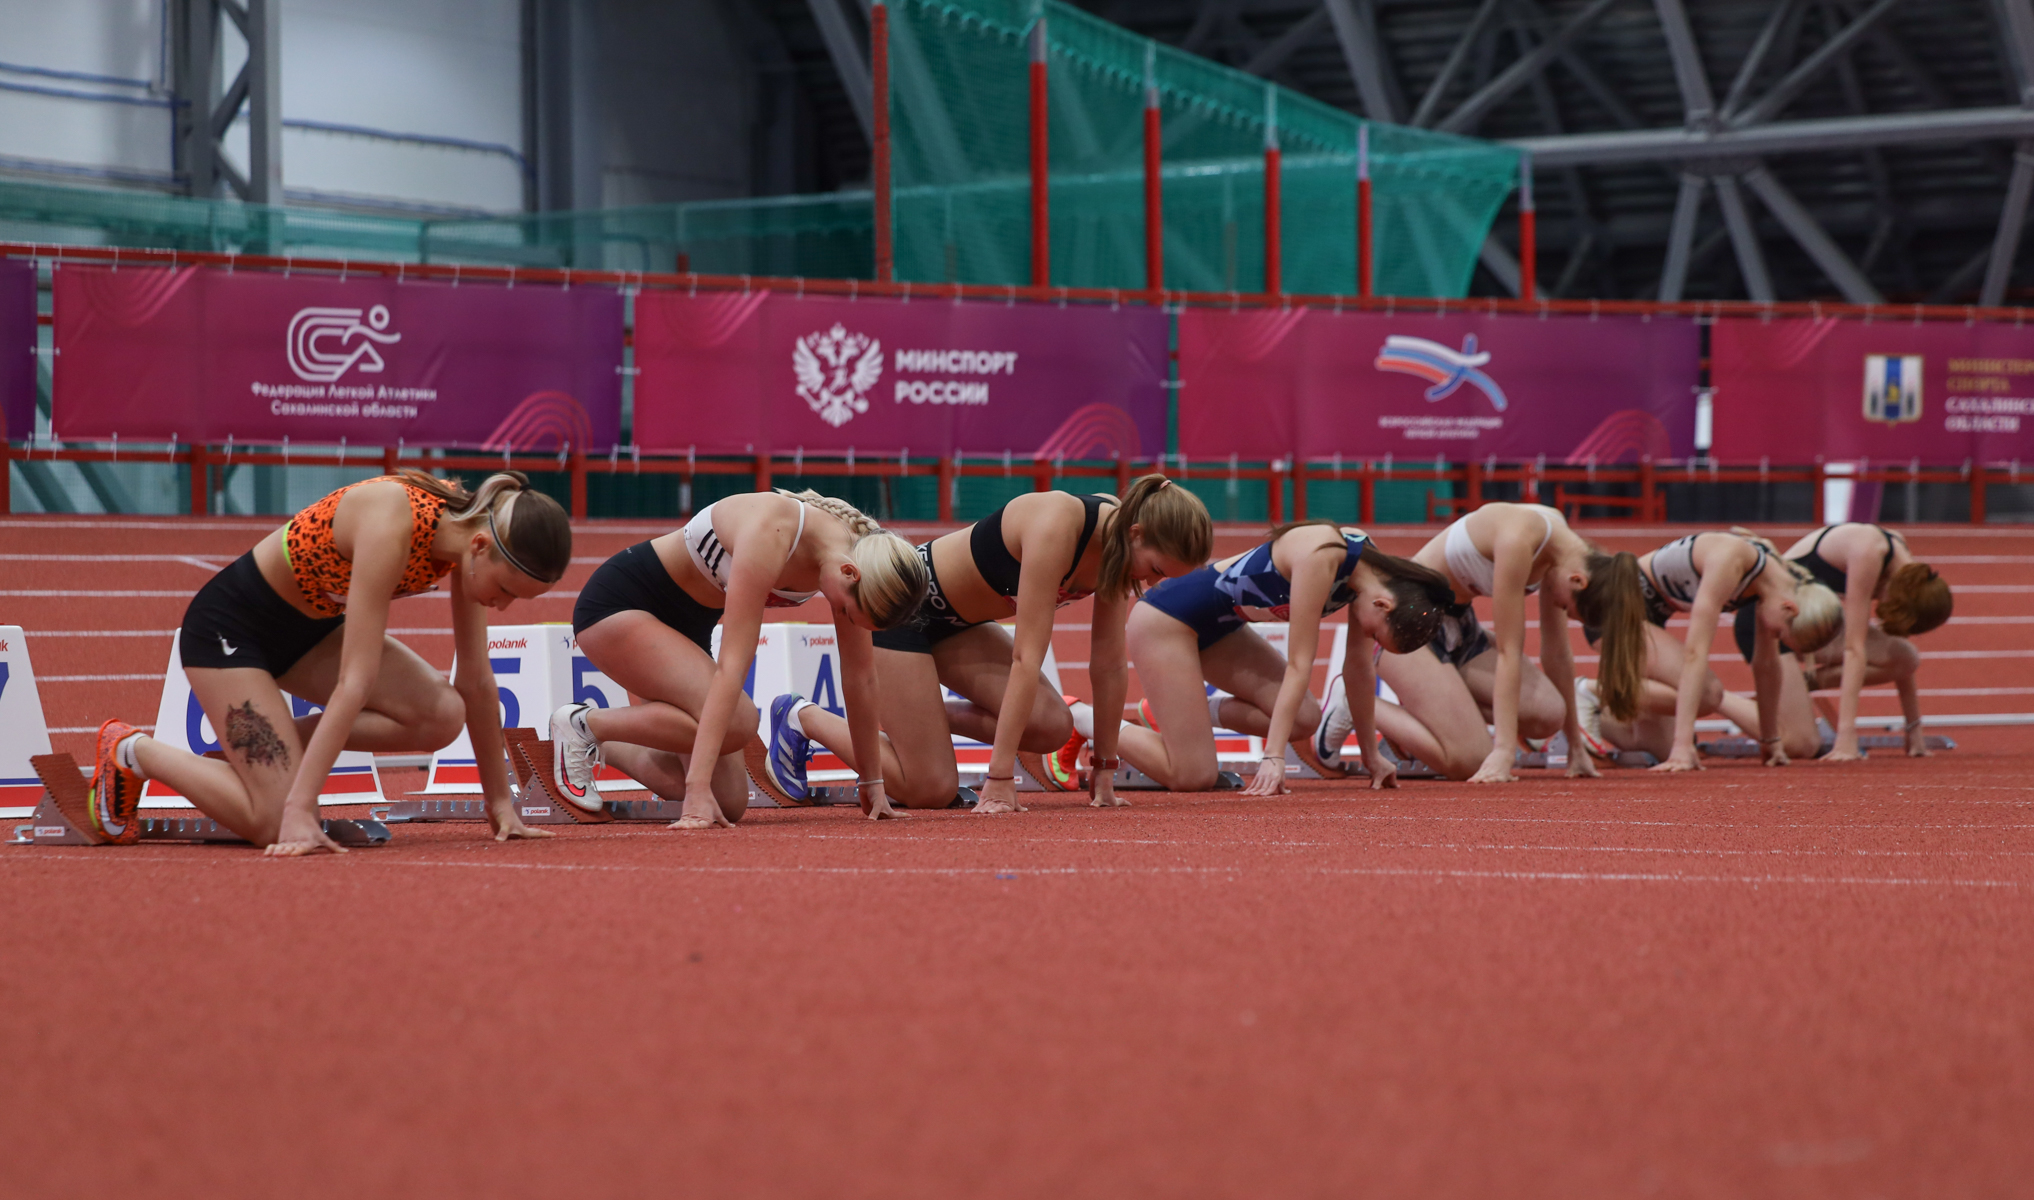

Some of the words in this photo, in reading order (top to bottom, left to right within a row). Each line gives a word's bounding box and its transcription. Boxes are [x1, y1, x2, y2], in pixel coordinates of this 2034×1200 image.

[895, 349, 1018, 375] МИНСПОРТ
[251, 381, 326, 399] Федерация
[377, 385, 437, 401] Атлетики
[895, 380, 989, 405] РОССИИ
[271, 399, 359, 417] Сахалинской
[362, 401, 418, 418] области
[488, 637, 528, 652] polanik
